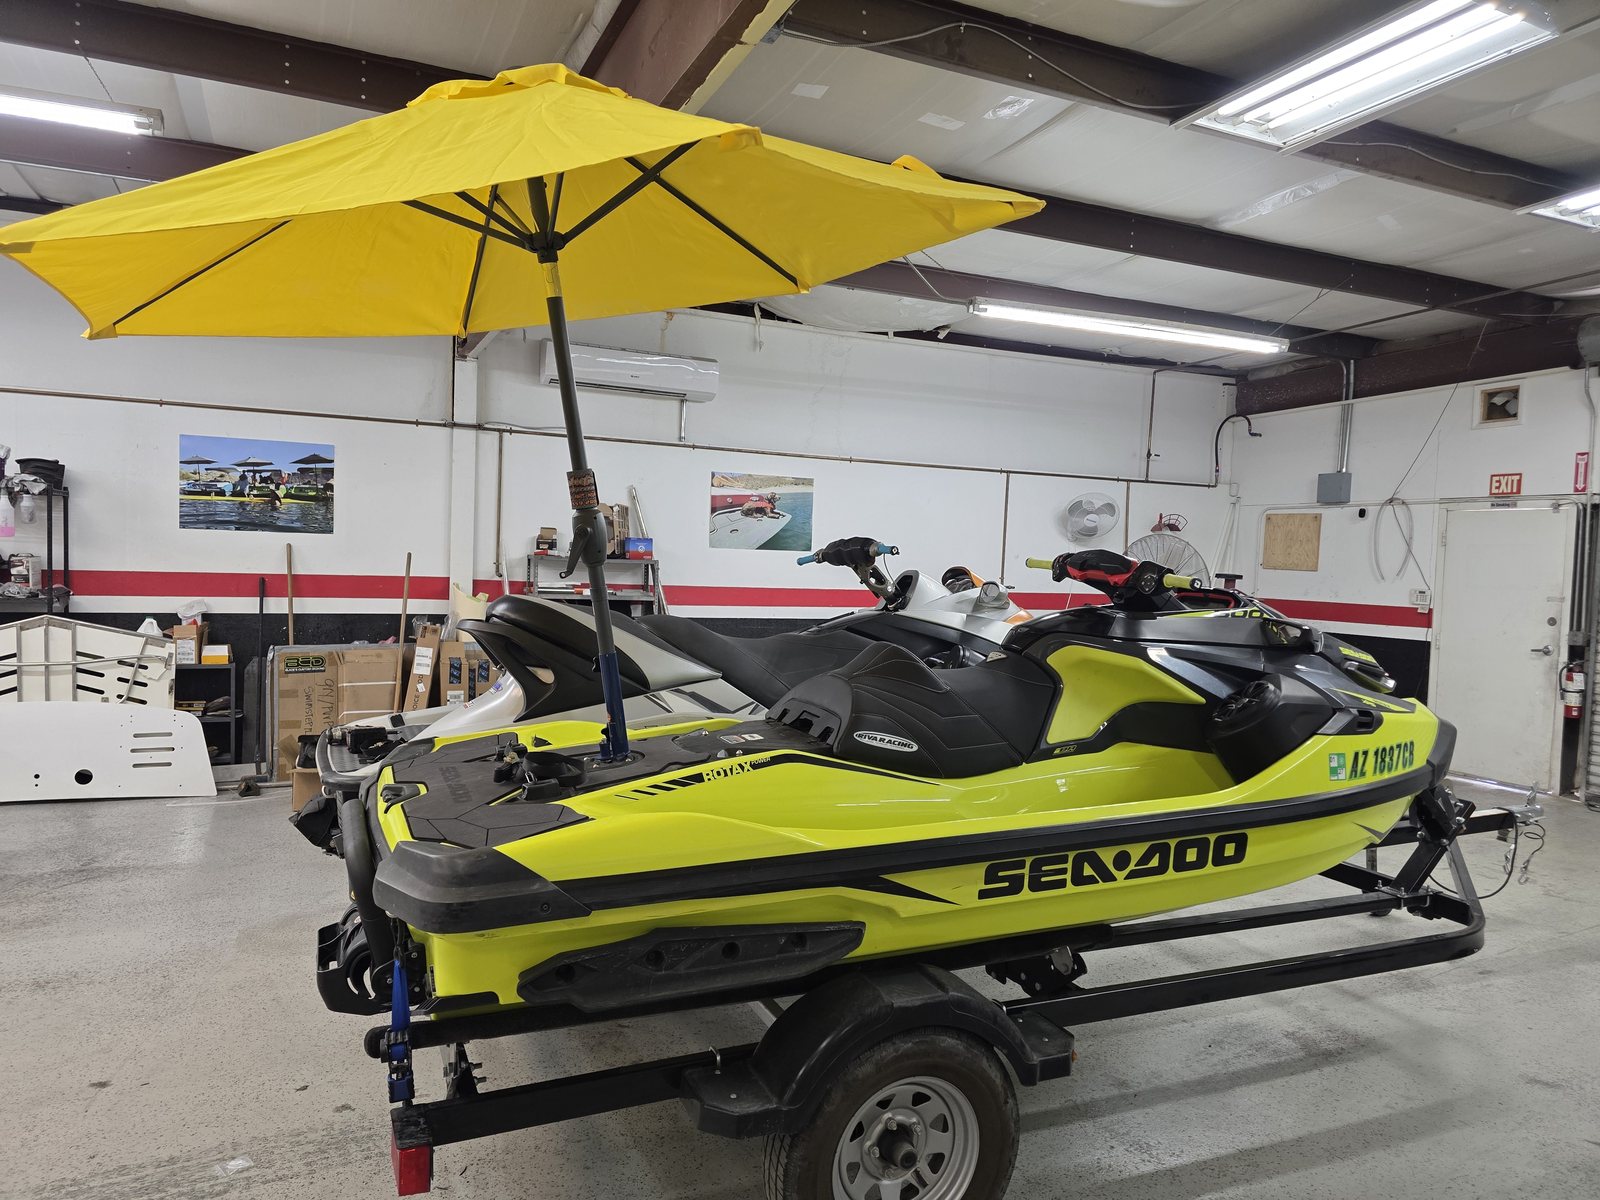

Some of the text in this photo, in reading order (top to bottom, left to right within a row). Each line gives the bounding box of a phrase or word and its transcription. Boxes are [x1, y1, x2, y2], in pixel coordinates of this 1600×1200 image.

[1491, 475, 1520, 494] EXIT
[858, 733, 914, 749] RIVA RACING
[703, 757, 771, 782] ROTAX POWER
[1348, 750, 1369, 780] AZ
